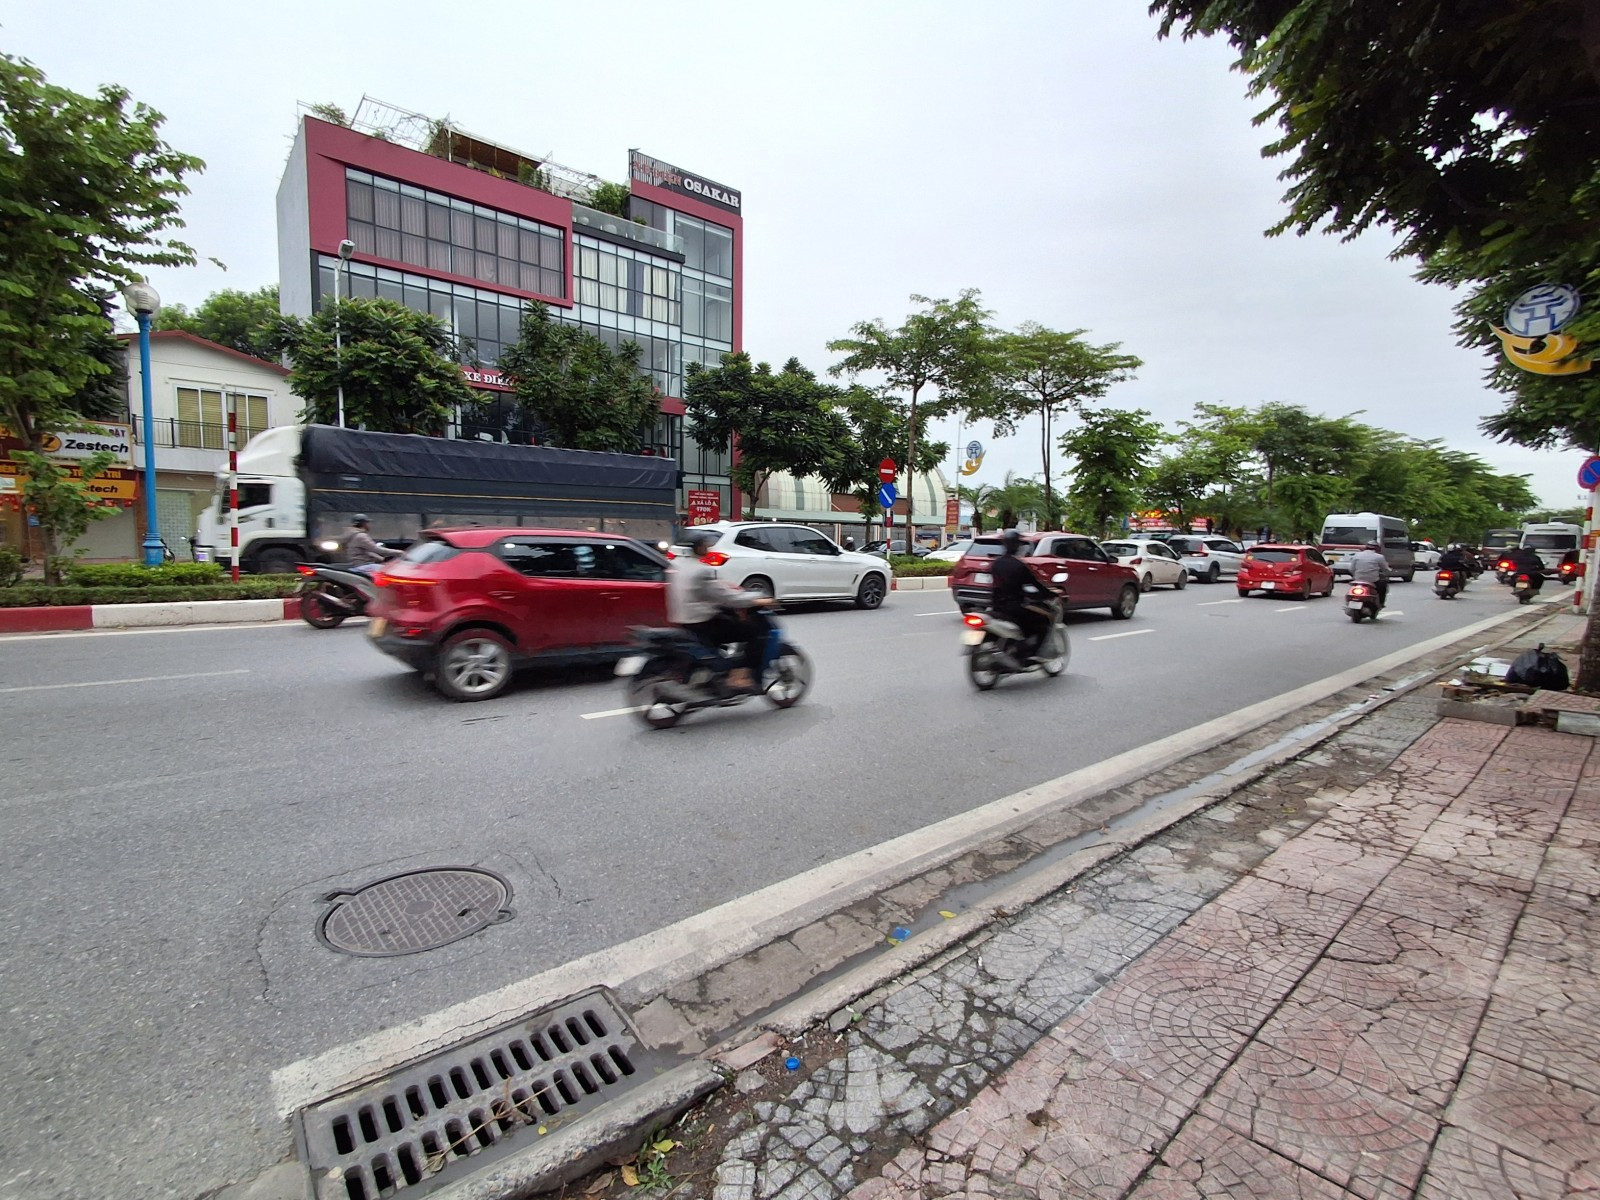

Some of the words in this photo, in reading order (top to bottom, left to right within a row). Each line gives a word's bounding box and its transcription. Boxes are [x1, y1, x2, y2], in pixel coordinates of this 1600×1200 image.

[683, 178, 739, 207] OSAKAR
[463, 371, 481, 382] XE
[65, 439, 129, 453] Zestech
